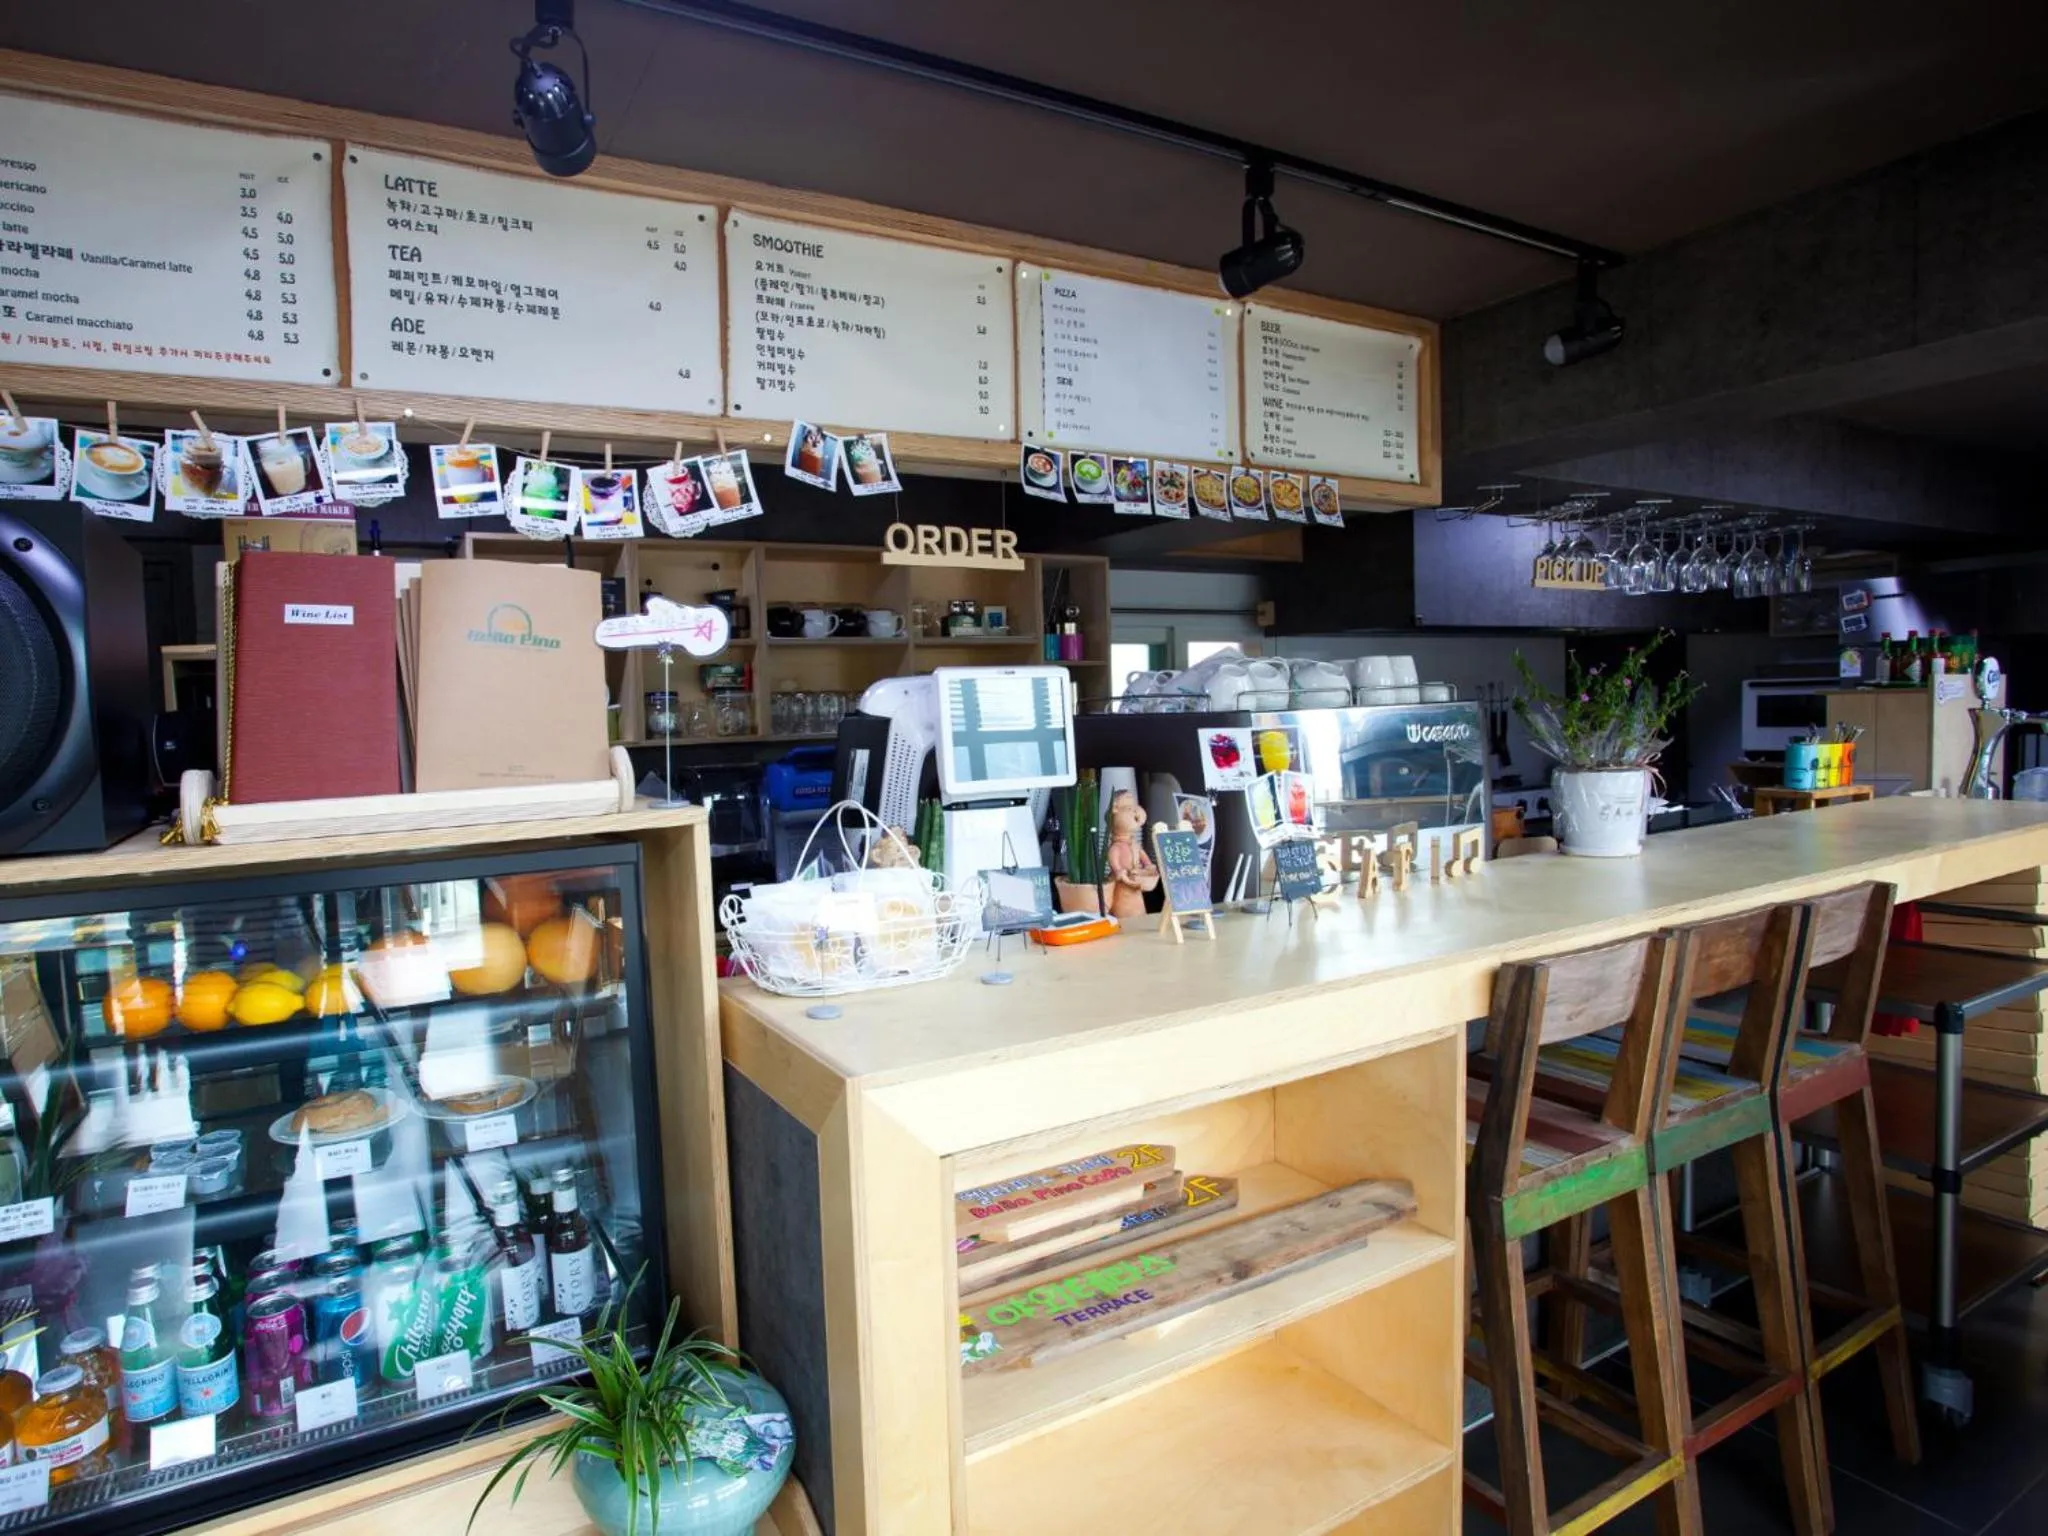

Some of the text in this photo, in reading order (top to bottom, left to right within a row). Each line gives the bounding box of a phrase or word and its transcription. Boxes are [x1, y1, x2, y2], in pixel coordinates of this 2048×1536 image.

[384, 174, 438, 197] LATTE
[242, 226, 258, 239] 4.5
[387, 216, 438, 235] 아이스티
[243, 247, 260, 261] 4.5
[388, 245, 422, 263] TEA
[753, 233, 824, 258] SMOOTHIE
[1, 265, 40, 279] mocha
[169, 264, 193, 274] latte
[244, 268, 296, 285] 4.8 5.3
[41, 291, 80, 304] mocha
[245, 288, 297, 305] 4.8 5.3
[25, 311, 74, 326] Caramel
[76, 317, 134, 331] macchiato
[246, 309, 298, 325] 4.8 5.3
[391, 316, 425, 335] ADE
[247, 328, 300, 344] 4.8 5.3
[884, 522, 1019, 559] ORDER
[1053, 1288, 1155, 1328] TERRACE
